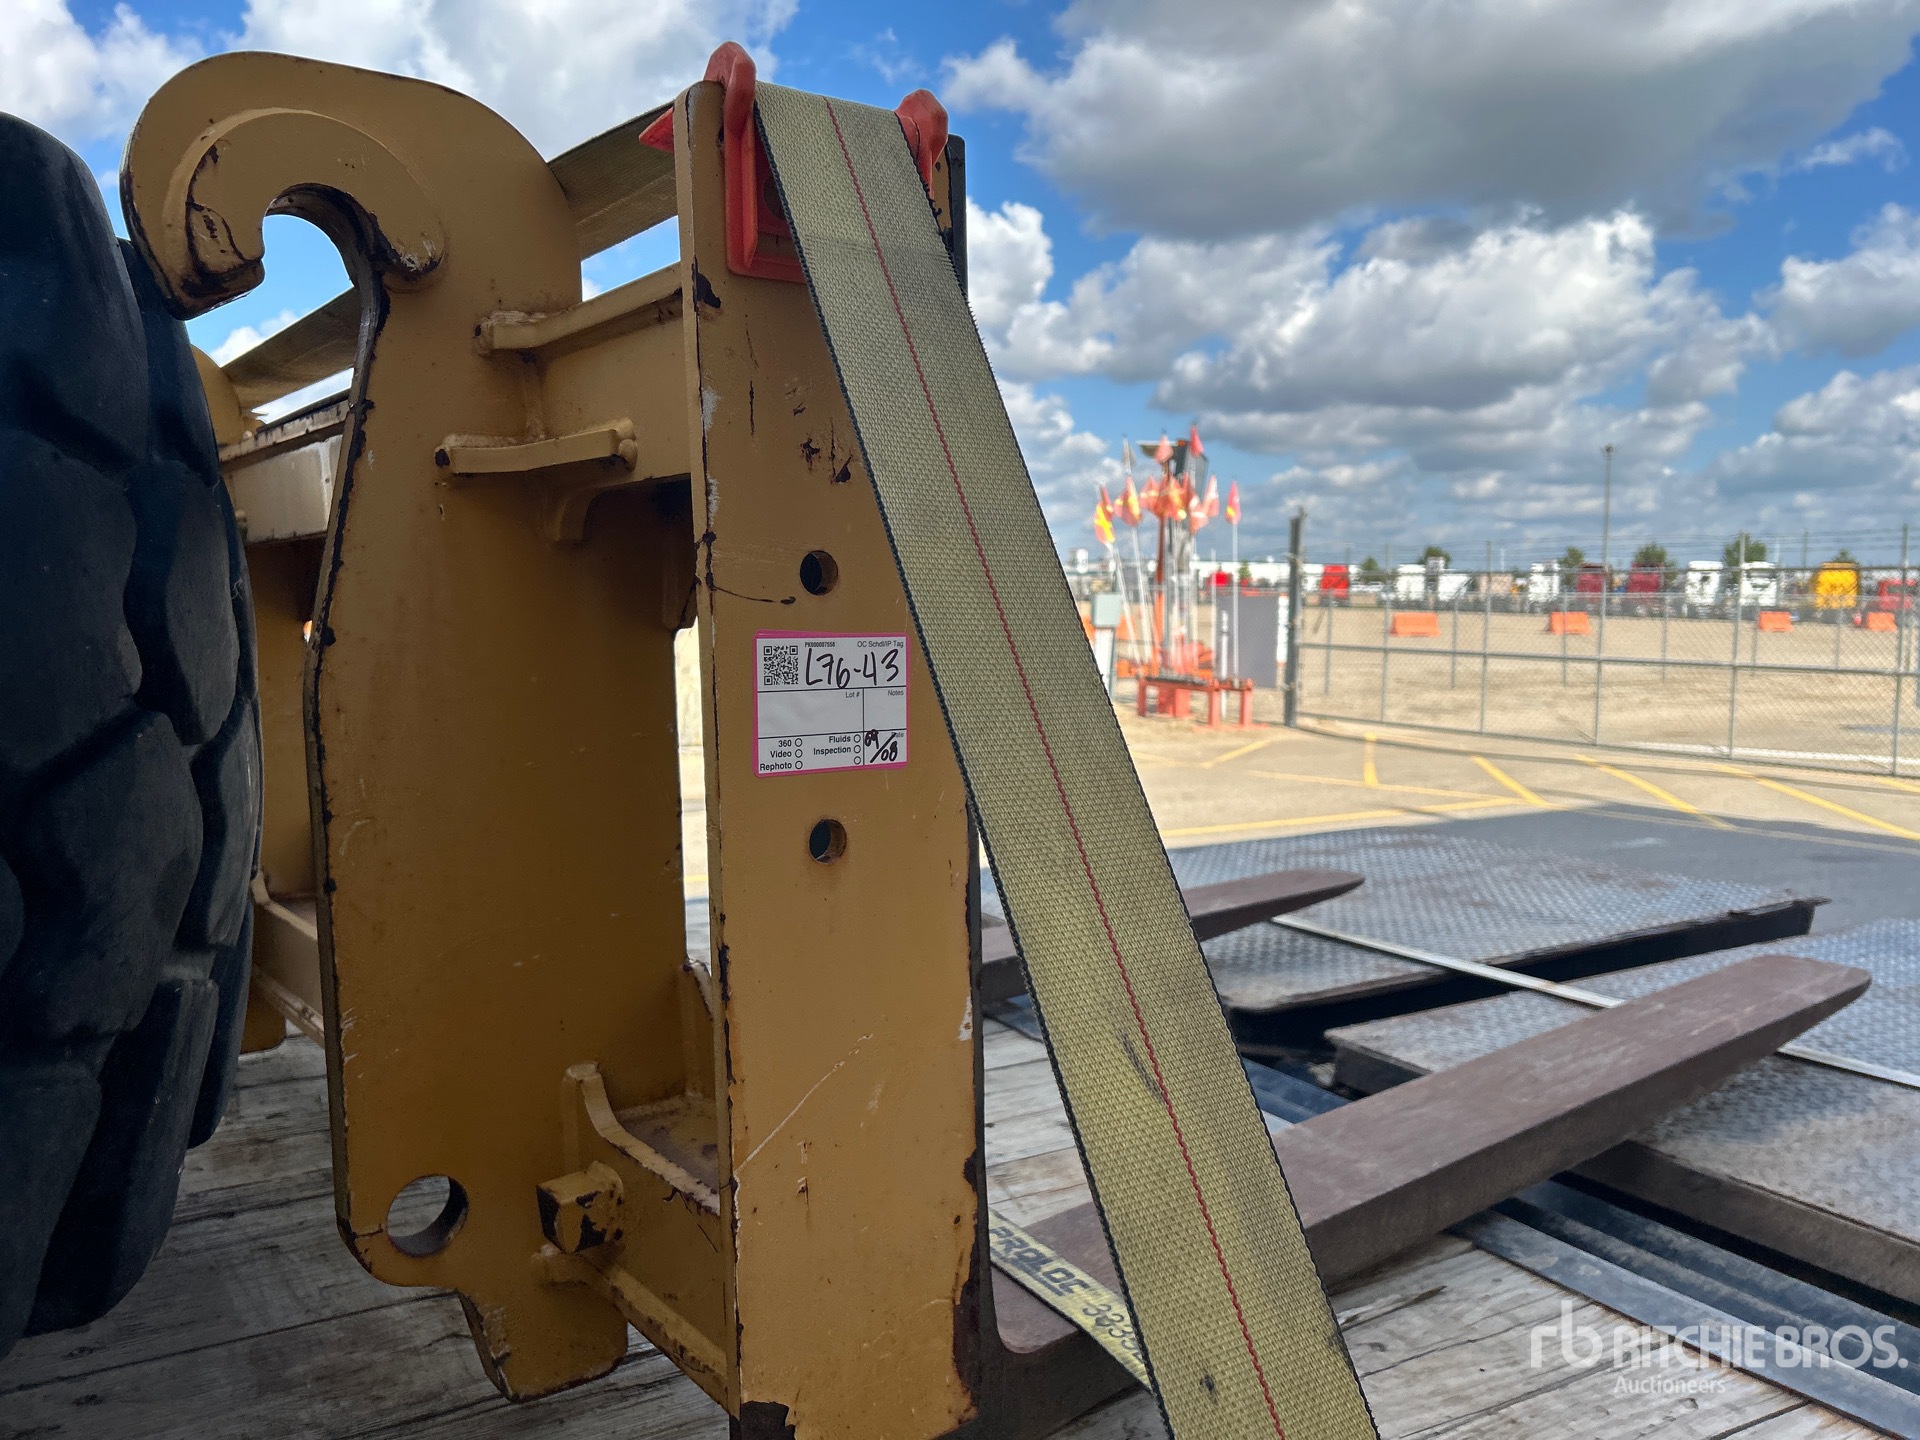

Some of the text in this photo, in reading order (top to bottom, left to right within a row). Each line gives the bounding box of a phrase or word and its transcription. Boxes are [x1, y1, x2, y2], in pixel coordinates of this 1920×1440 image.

[857, 640, 868, 648] OC
[892, 640, 904, 649] Tag
[805, 648, 899, 689] L76-43
[887, 689, 904, 697] Notes
[778, 739, 792, 747] 360
[828, 735, 851, 743] Fluids
[770, 750, 792, 758] Video
[813, 746, 852, 756] Inspection
[759, 762, 792, 772] Rephoto
